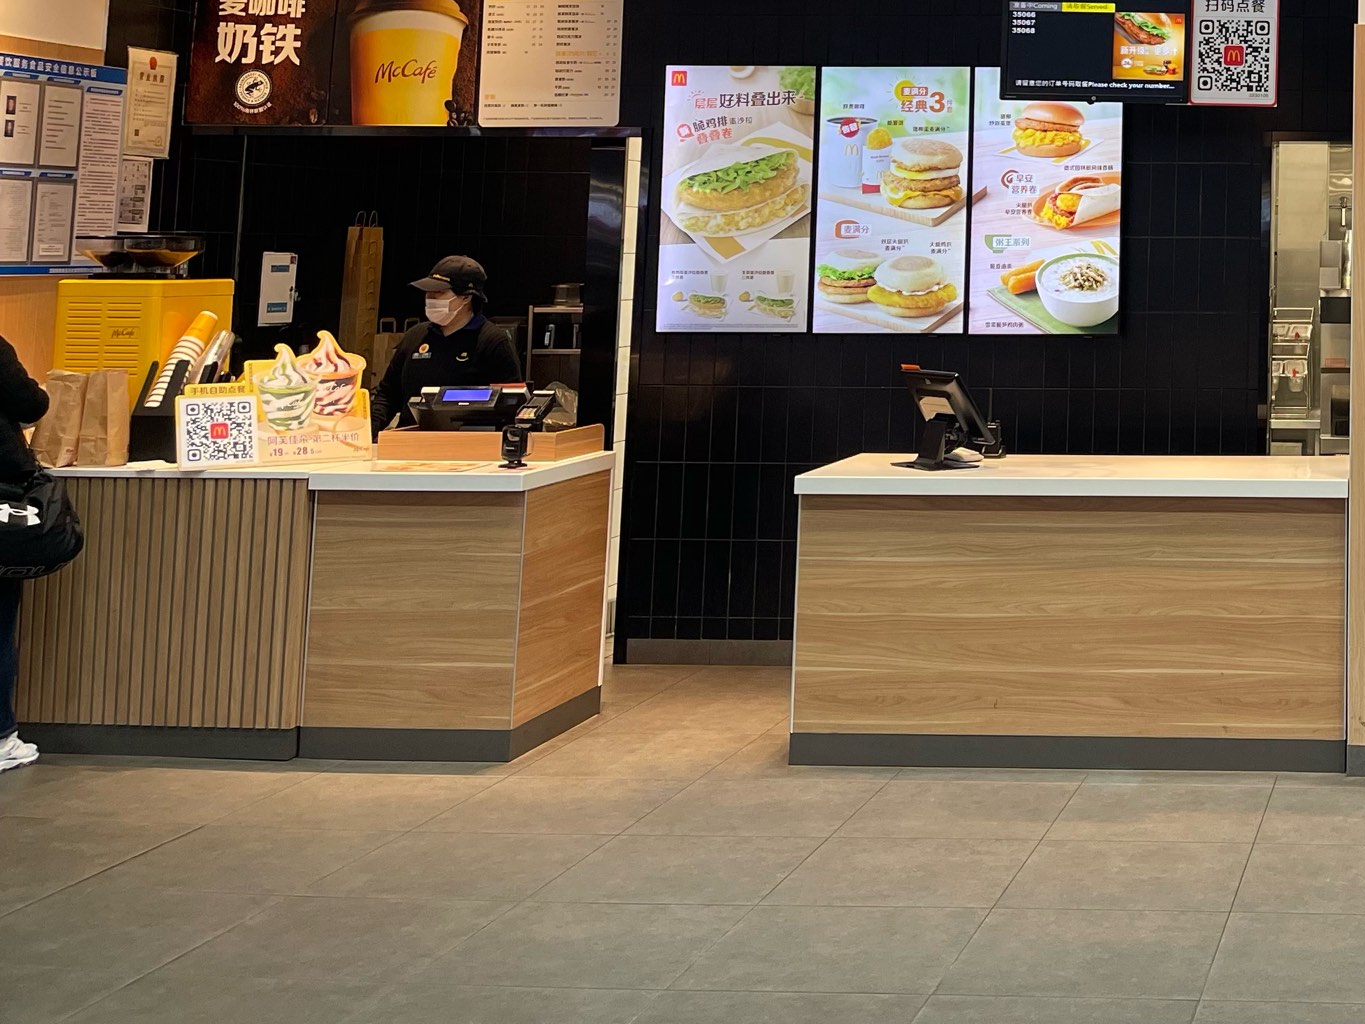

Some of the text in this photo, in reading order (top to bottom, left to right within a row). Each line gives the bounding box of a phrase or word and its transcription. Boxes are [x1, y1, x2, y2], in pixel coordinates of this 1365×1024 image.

[215, 22, 302, 65] 奶铁
[374, 59, 438, 84] McCafé
[1109, 81, 1128, 89] check
[1129, 83, 1144, 91] your
[902, 87, 927, 96] 麦满分
[1016, 174, 1033, 183] 早安
[1011, 185, 1038, 194] 营养卷
[843, 225, 869, 234] 麦满分
[995, 237, 1030, 247] 粥王系列
[190, 385, 246, 396] 手机自助点餐
